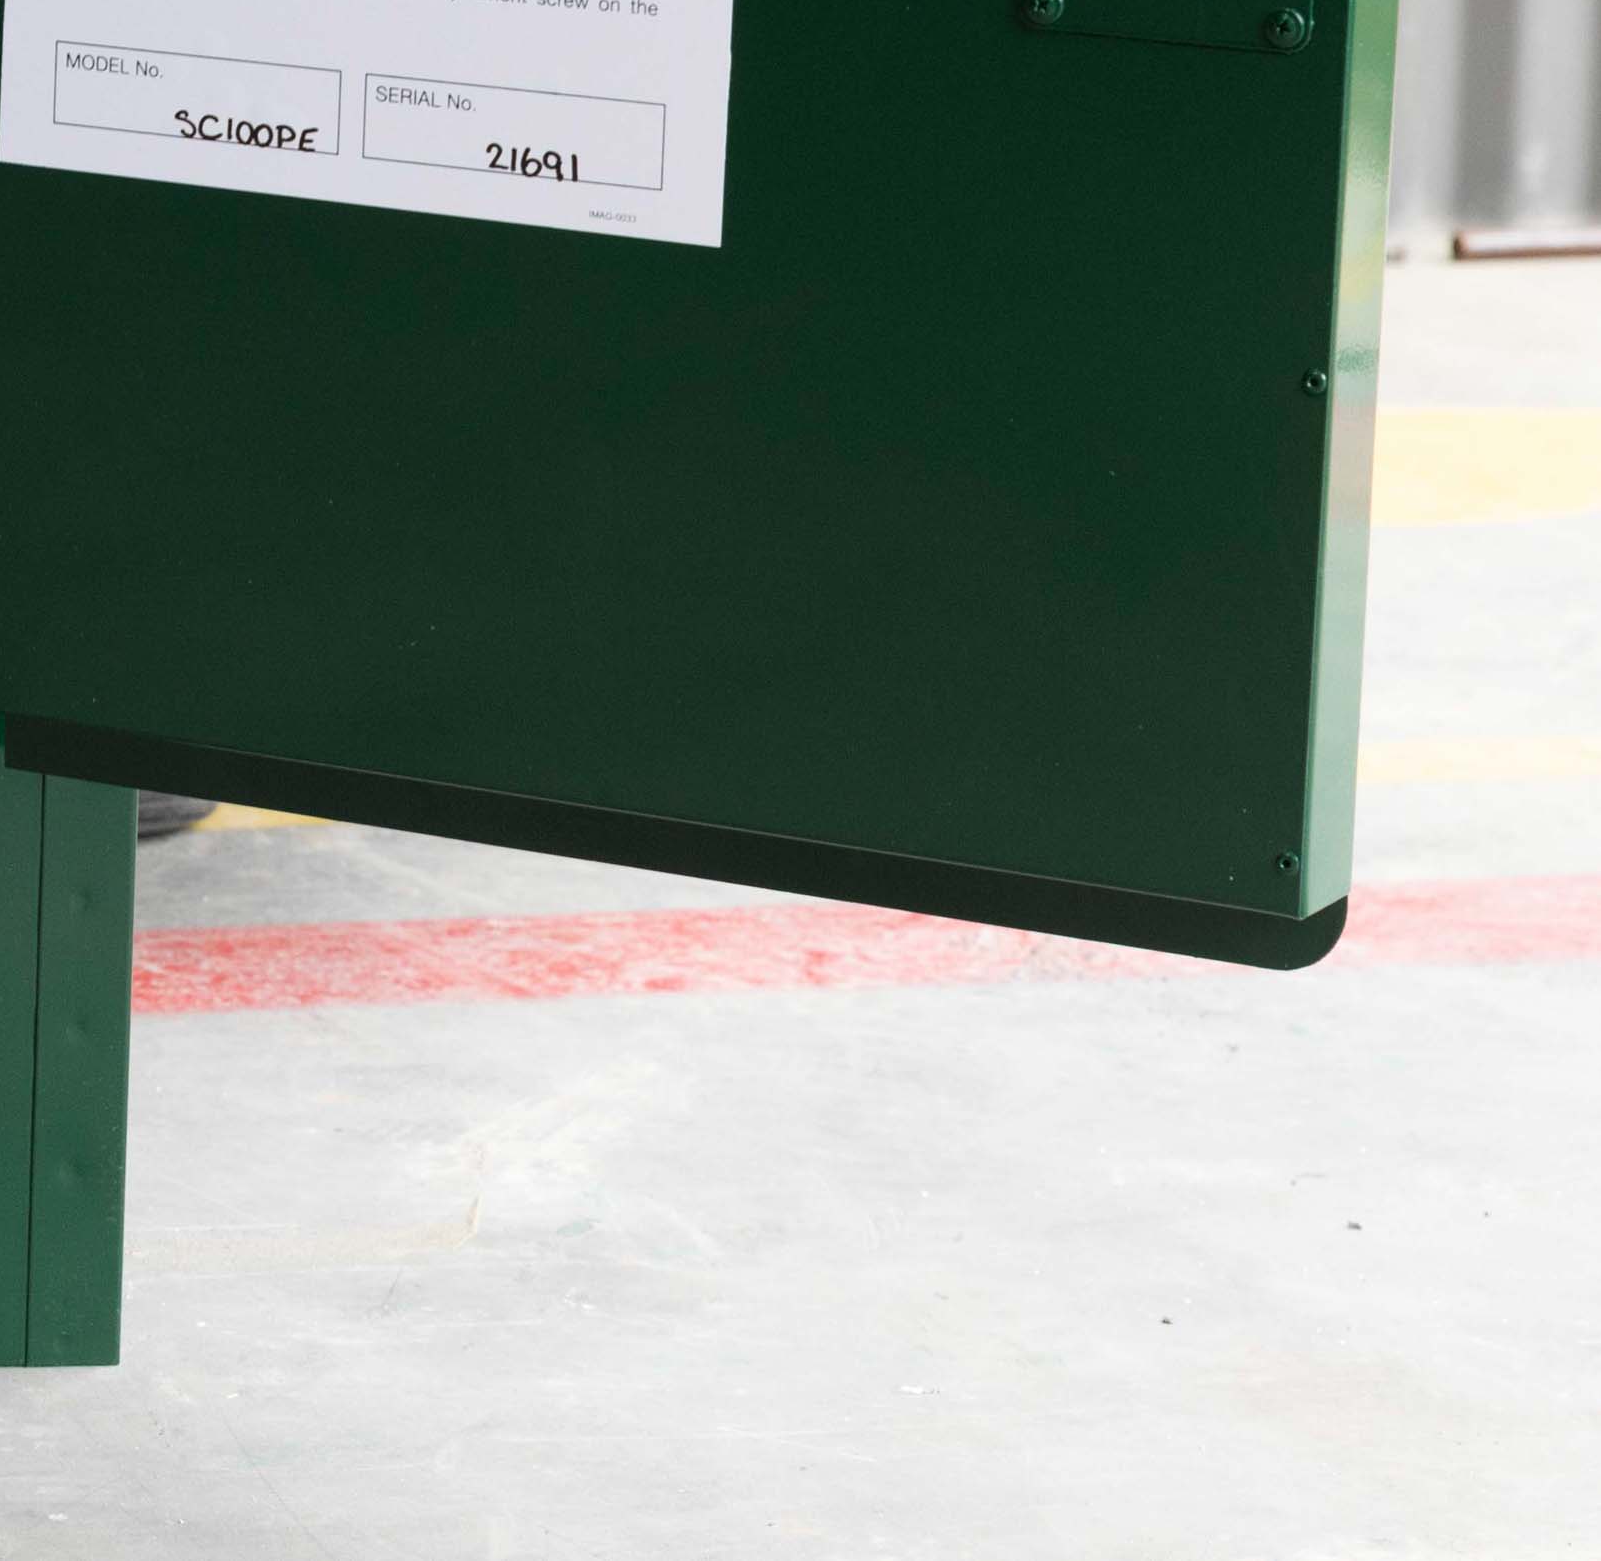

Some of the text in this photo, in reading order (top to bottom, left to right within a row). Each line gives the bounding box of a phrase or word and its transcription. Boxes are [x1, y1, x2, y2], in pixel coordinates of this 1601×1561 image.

[64, 51, 164, 79] MODEL No.
[374, 84, 477, 112] SERIAL No.
[173, 109, 319, 153] SC100PE
[485, 142, 579, 183] 21691
